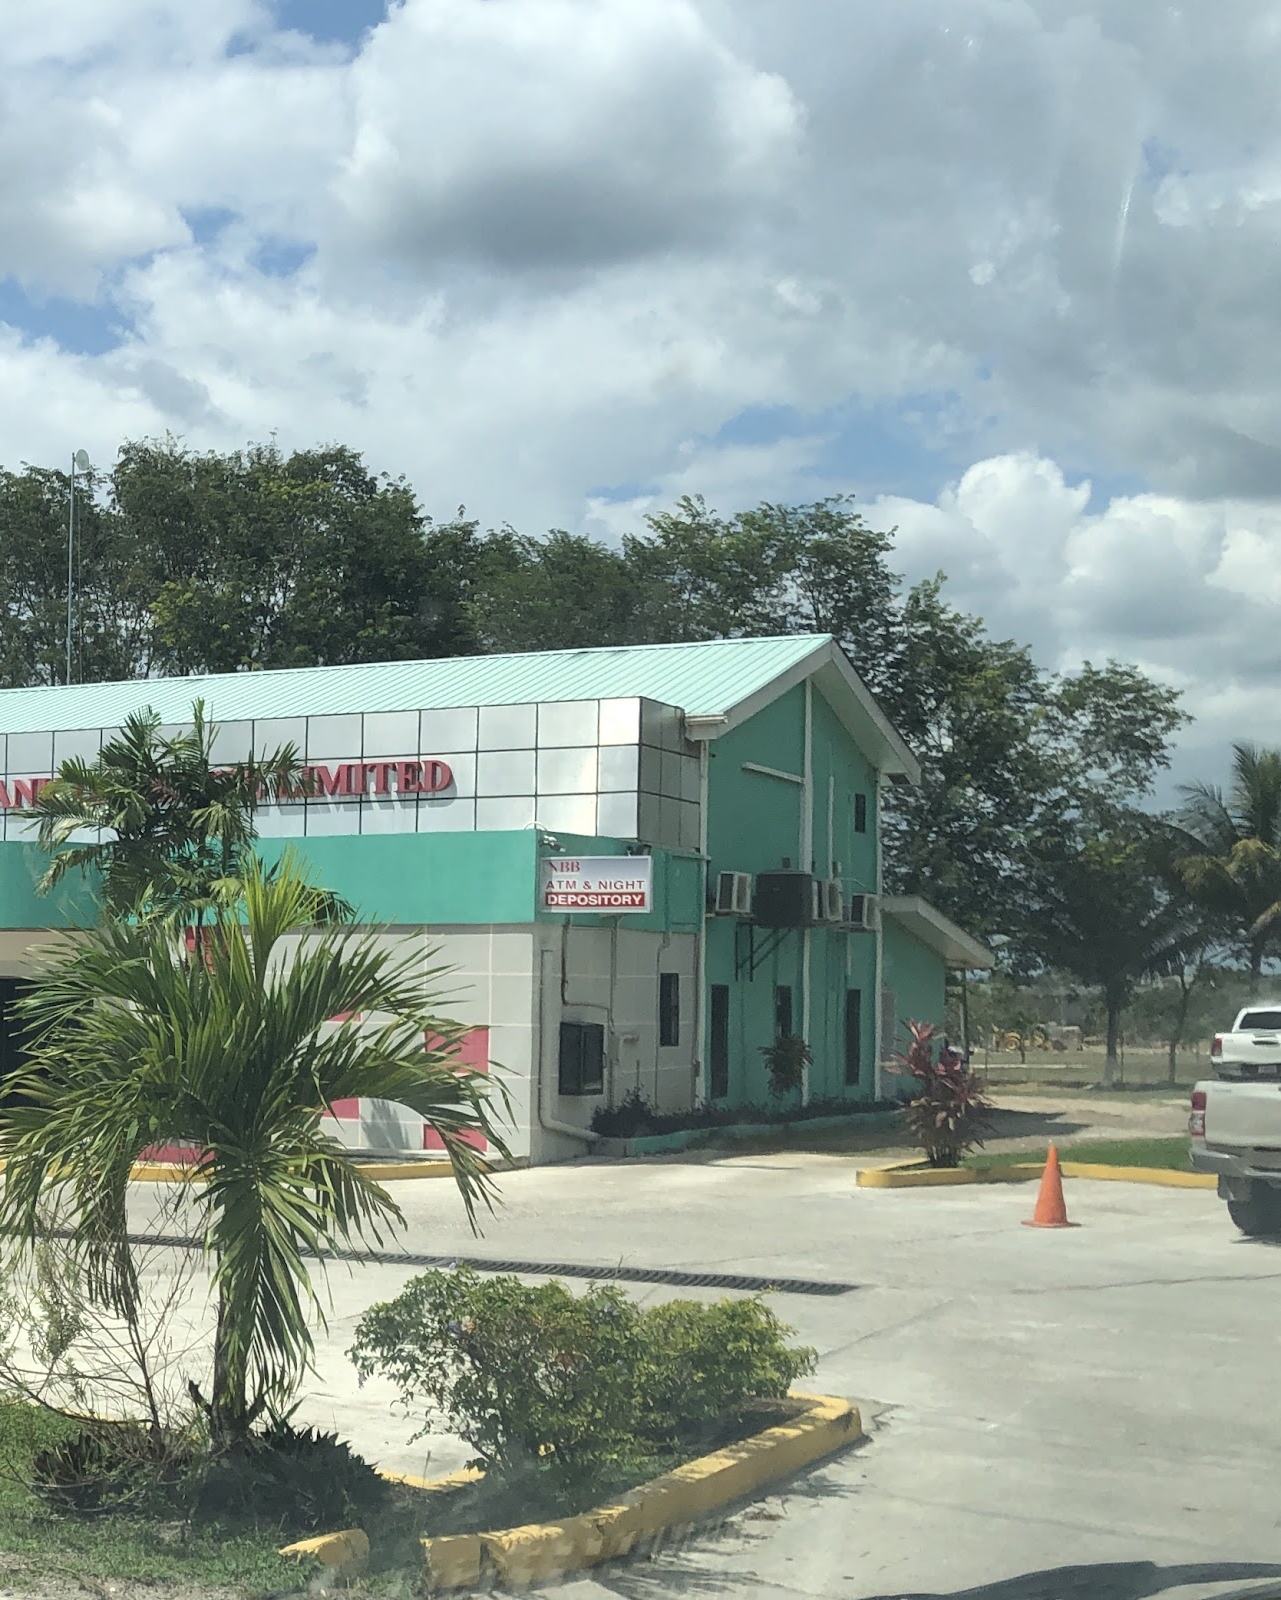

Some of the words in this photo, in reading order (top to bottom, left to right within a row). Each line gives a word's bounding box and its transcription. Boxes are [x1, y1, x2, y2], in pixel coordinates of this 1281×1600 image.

[545, 880, 577, 890] ATM
[582, 880, 592, 890] &
[598, 880, 645, 890] NIGHT
[547, 894, 643, 905] DEPOSITORY
